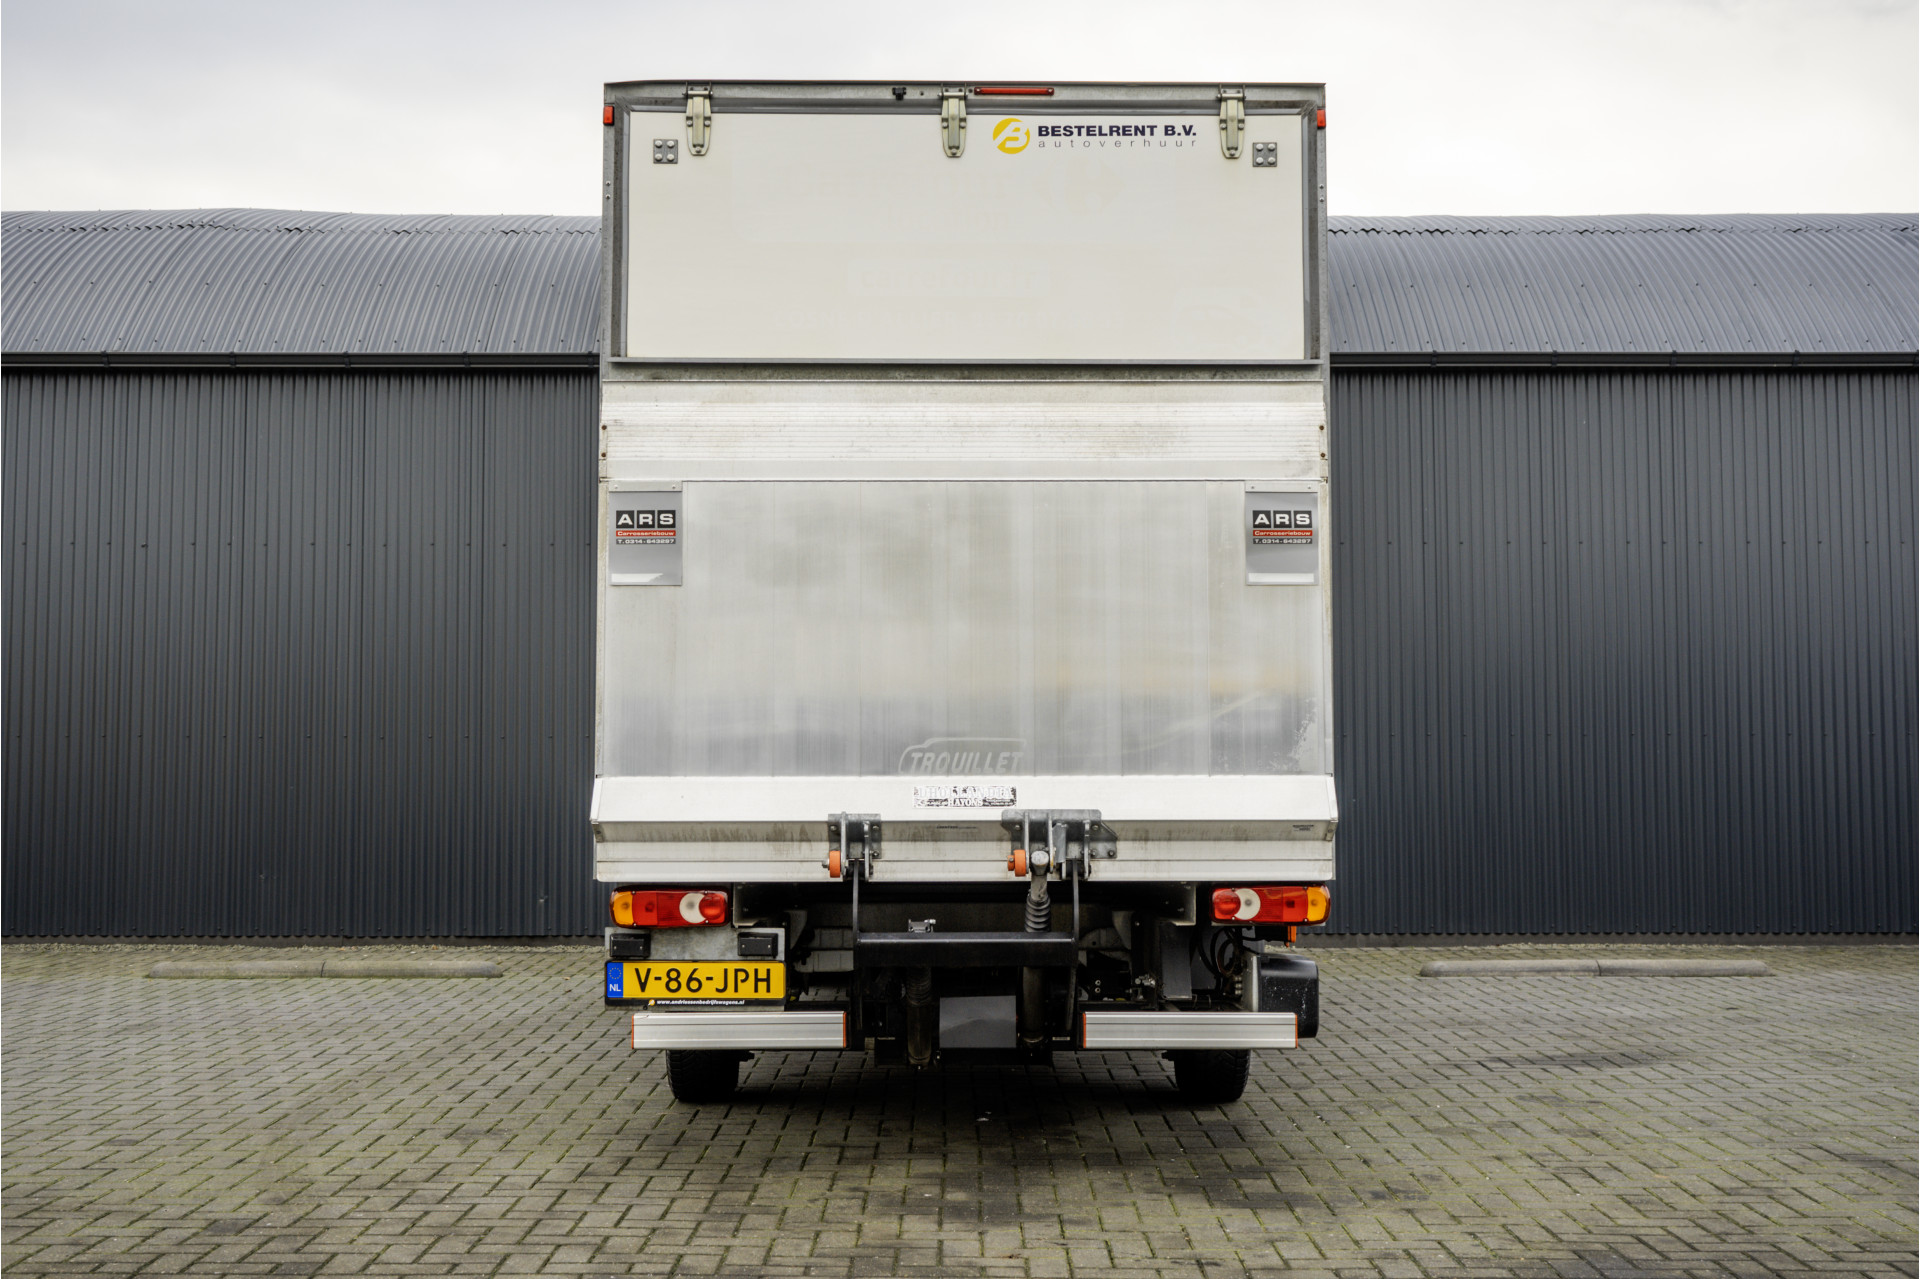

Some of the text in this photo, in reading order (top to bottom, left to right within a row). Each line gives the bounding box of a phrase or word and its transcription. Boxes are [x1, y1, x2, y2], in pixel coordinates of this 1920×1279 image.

[1037, 124, 1197, 137] BESTELRENT B.V.
[1038, 138, 1197, 148] autoverhuur
[617, 513, 674, 526] ARS
[1254, 513, 1311, 525] ARS
[910, 751, 1025, 775] TROUILLET
[634, 967, 772, 994] V-86-JPH
[609, 983, 622, 993] NL
